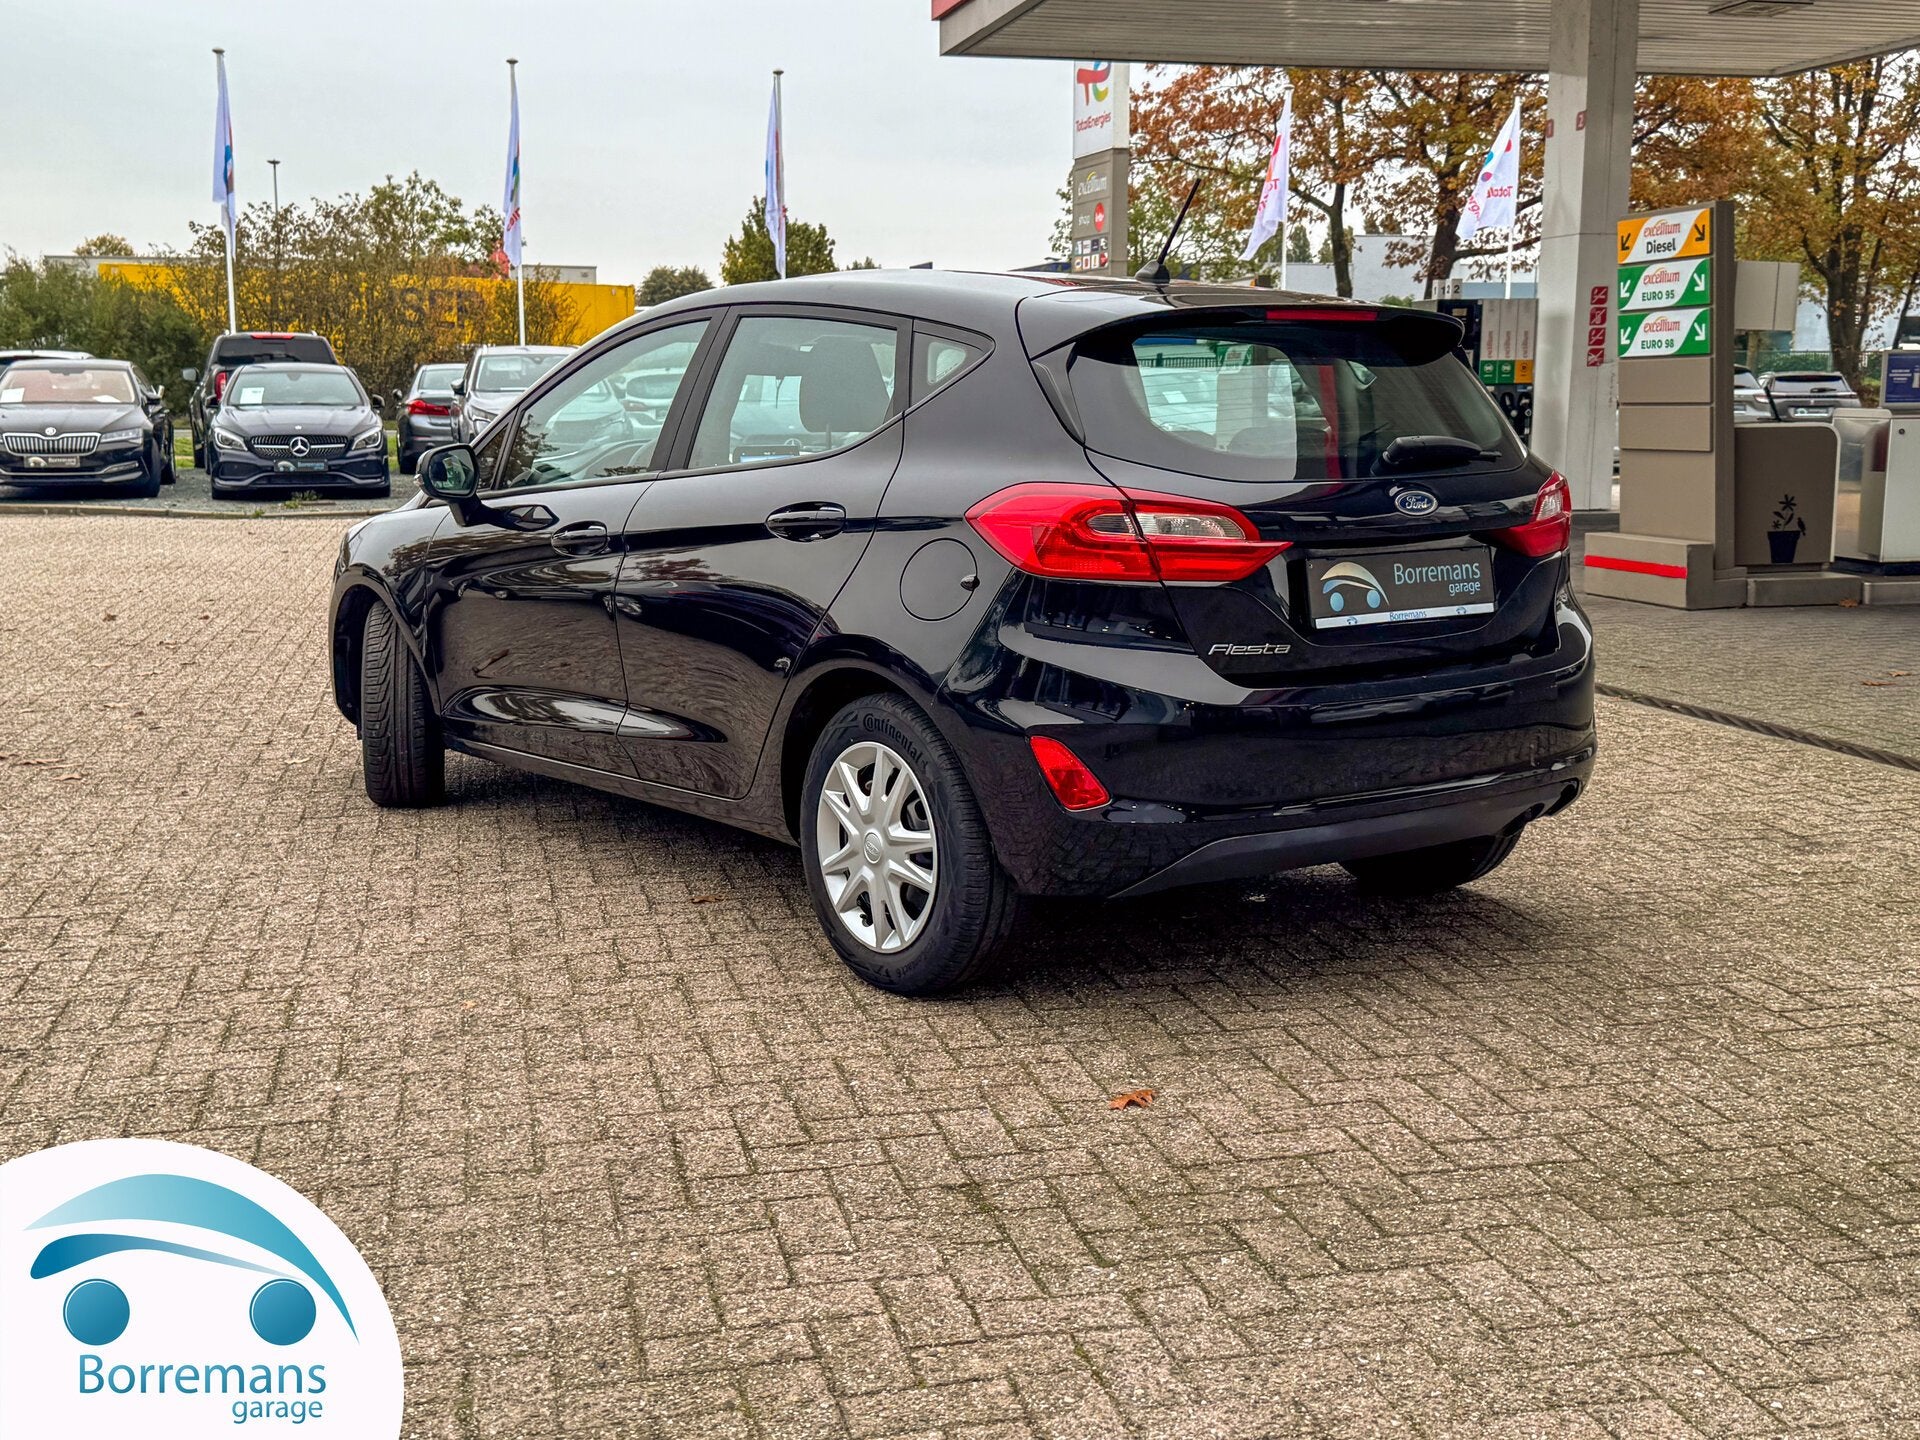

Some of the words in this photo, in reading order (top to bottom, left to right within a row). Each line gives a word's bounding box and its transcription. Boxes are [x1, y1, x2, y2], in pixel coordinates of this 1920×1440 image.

[1643, 220, 1681, 238] excellium
[1645, 238, 1676, 254] Diesel
[1643, 268, 1680, 286] excellium
[1453, 284, 1461, 294] 2
[1641, 290, 1663, 302] EURO
[1665, 289, 1675, 300] 95
[1643, 317, 1680, 333] excellium
[1640, 339, 1662, 350] EURO
[1664, 338, 1674, 349] 98
[1405, 495, 1431, 509] Ford
[1394, 562, 1481, 585] Borremans
[1448, 581, 1481, 597] garage
[1389, 610, 1427, 621] Borremans
[1208, 643, 1291, 656] Fiesta
[863, 713, 923, 764] Continental
